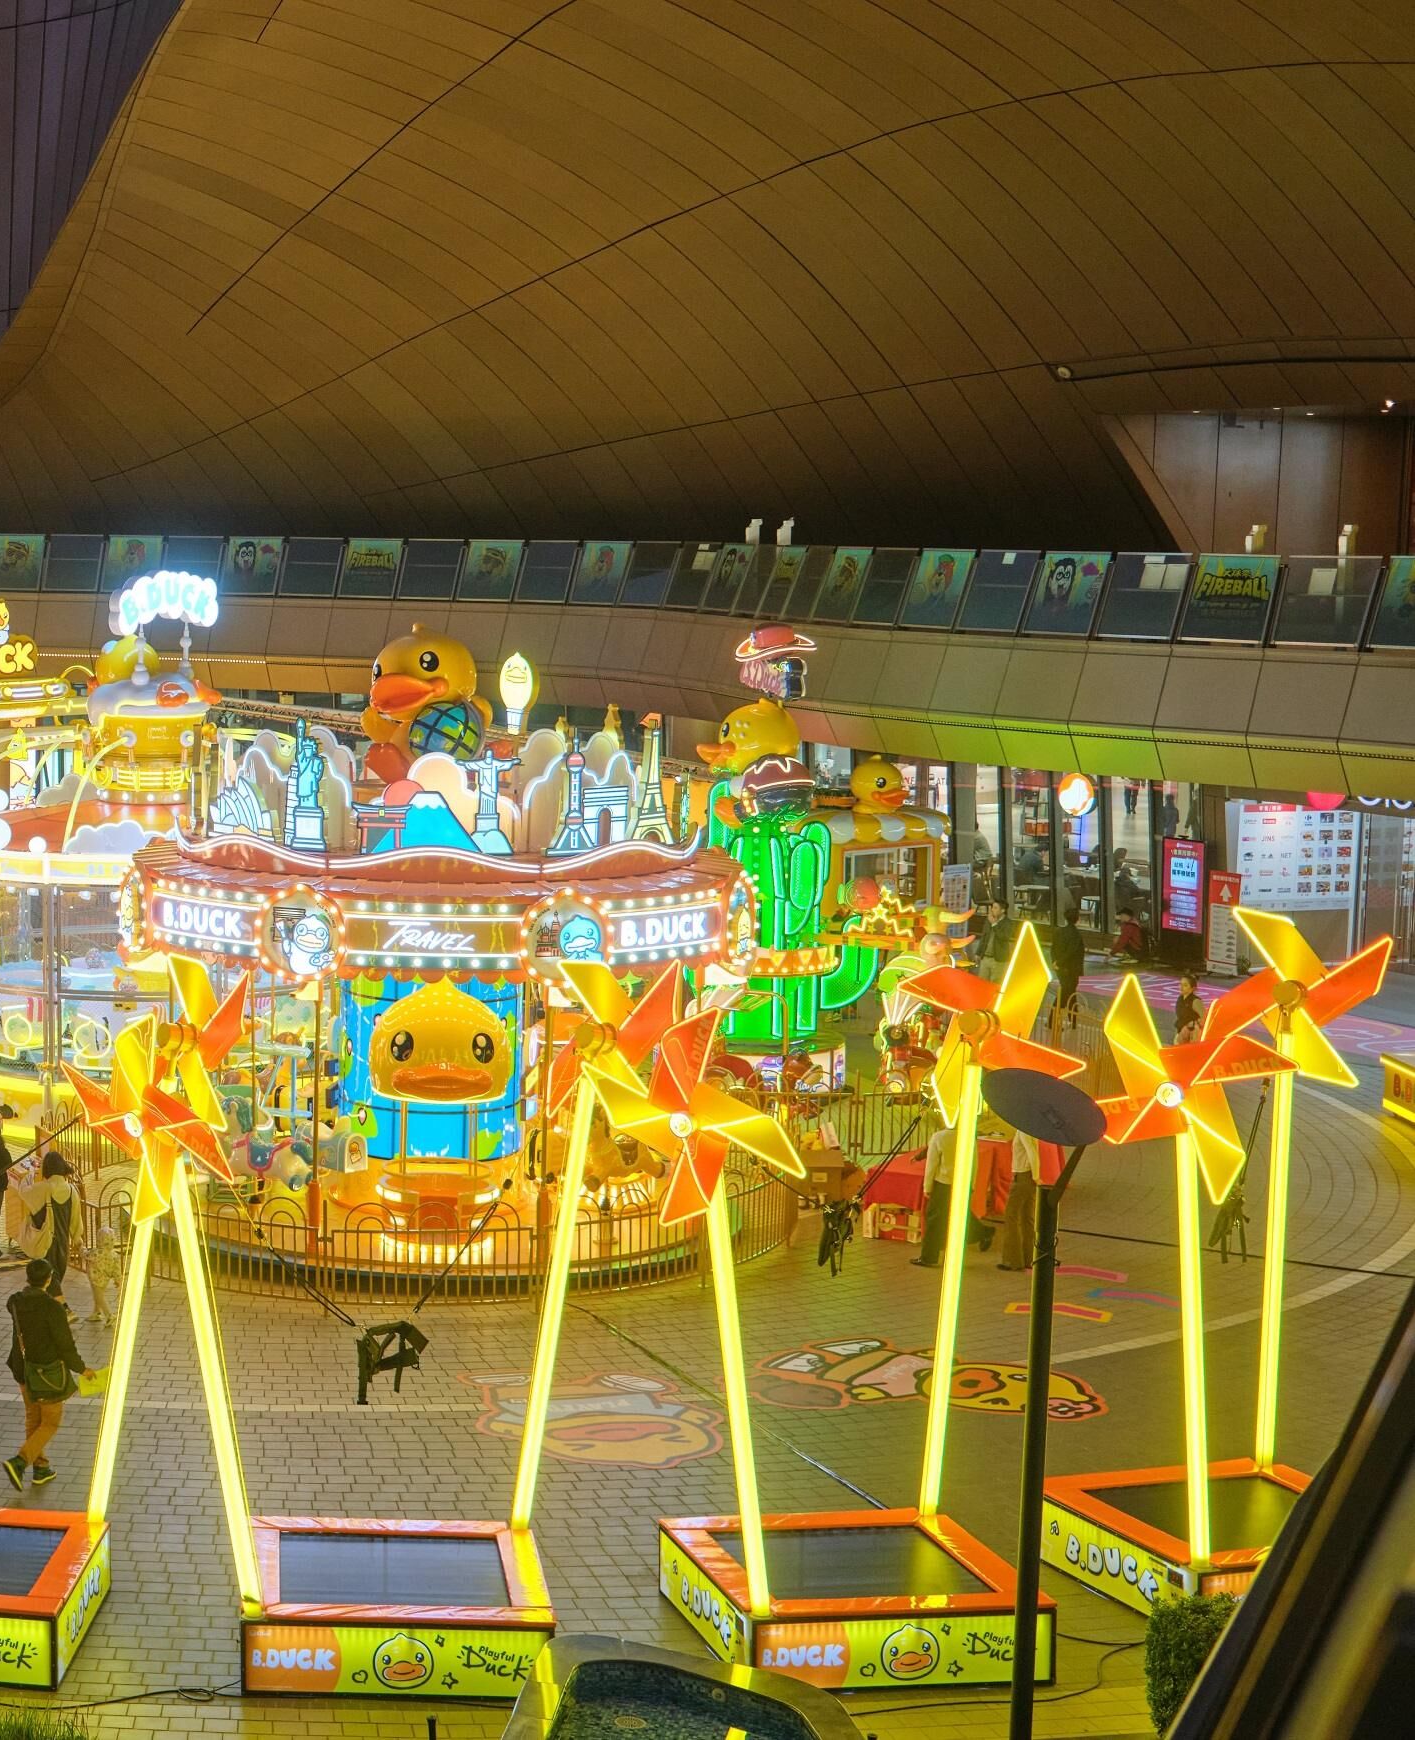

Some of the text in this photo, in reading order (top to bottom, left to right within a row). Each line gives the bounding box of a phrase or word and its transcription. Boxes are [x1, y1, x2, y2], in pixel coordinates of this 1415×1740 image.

[346, 551, 395, 570] FIREBALL
[121, 578, 211, 626] B.DUCK
[1191, 572, 1270, 601] FIREBALL
[162, 901, 242, 939] B.DUCK
[382, 919, 478, 952] TRAVEL
[619, 912, 706, 948] B.DUCK
[1213, 1056, 1282, 1078] B.DUCK
[1065, 1533, 1160, 1604] B.DUCK
[71, 1565, 101, 1643] B.DUCK
[680, 1575, 732, 1650] B.DUCK
[478, 1645, 516, 1662] Playful
[967, 1632, 1014, 1662] Duc
[983, 1631, 1015, 1646] Playfu
[251, 1648, 335, 1671] B.DUCK
[462, 1645, 529, 1681] Duck
[762, 1644, 845, 1667] B.DUCK
